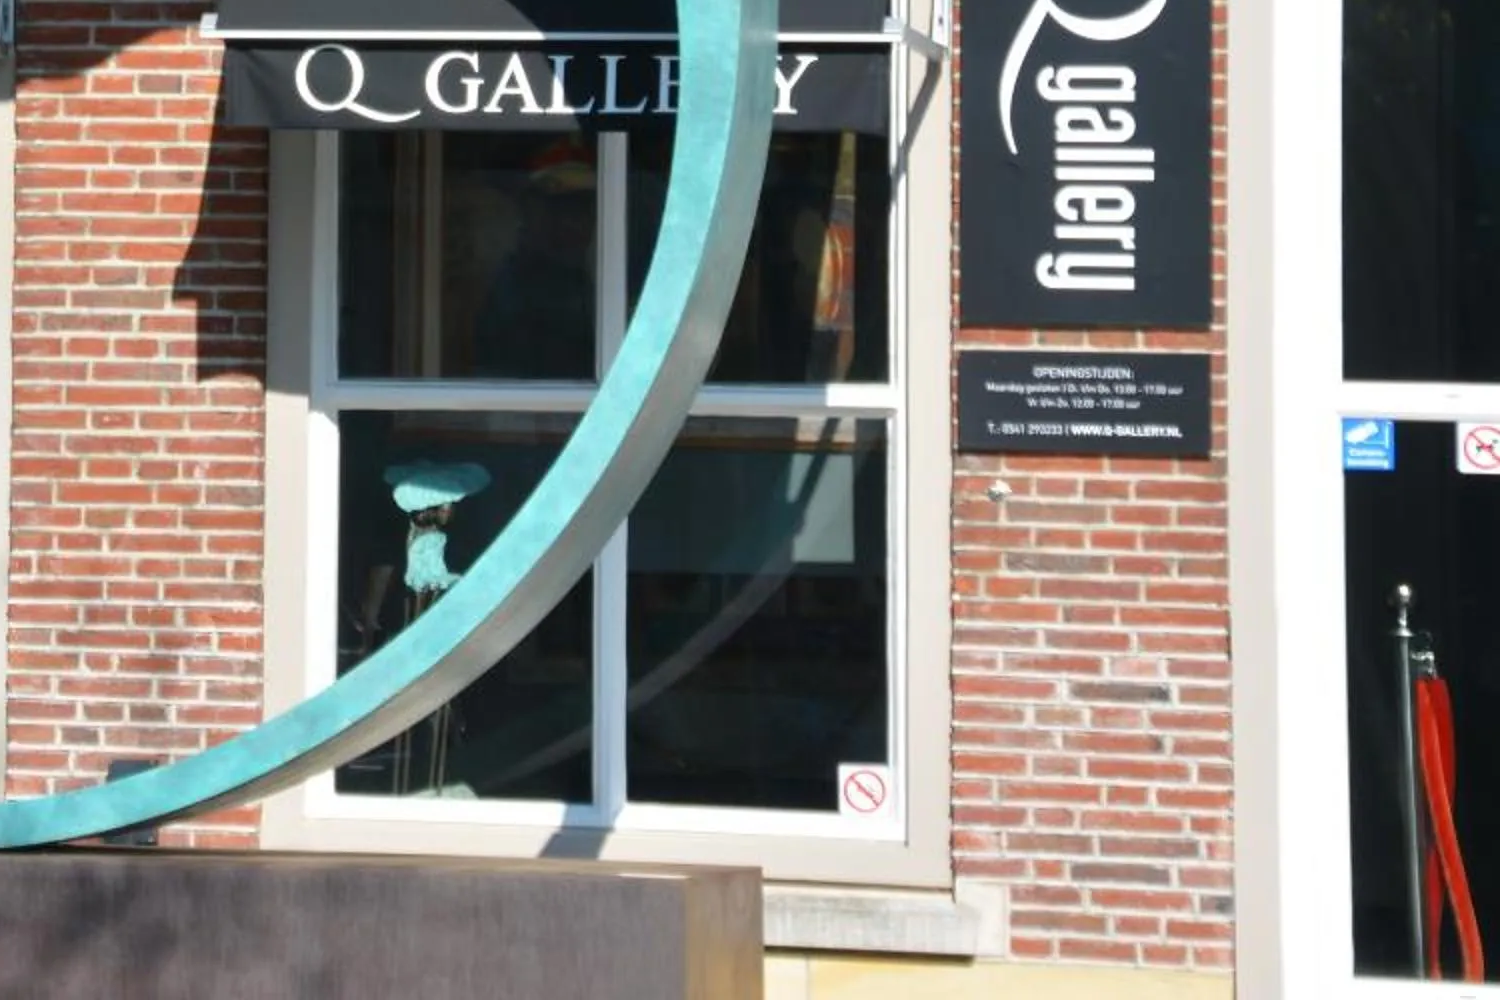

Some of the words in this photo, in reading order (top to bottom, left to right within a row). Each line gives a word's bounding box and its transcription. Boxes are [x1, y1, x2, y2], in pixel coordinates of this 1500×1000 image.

[295, 44, 421, 122] Q
[424, 51, 819, 115] GALLEY
[1035, 65, 1156, 291] gallery
